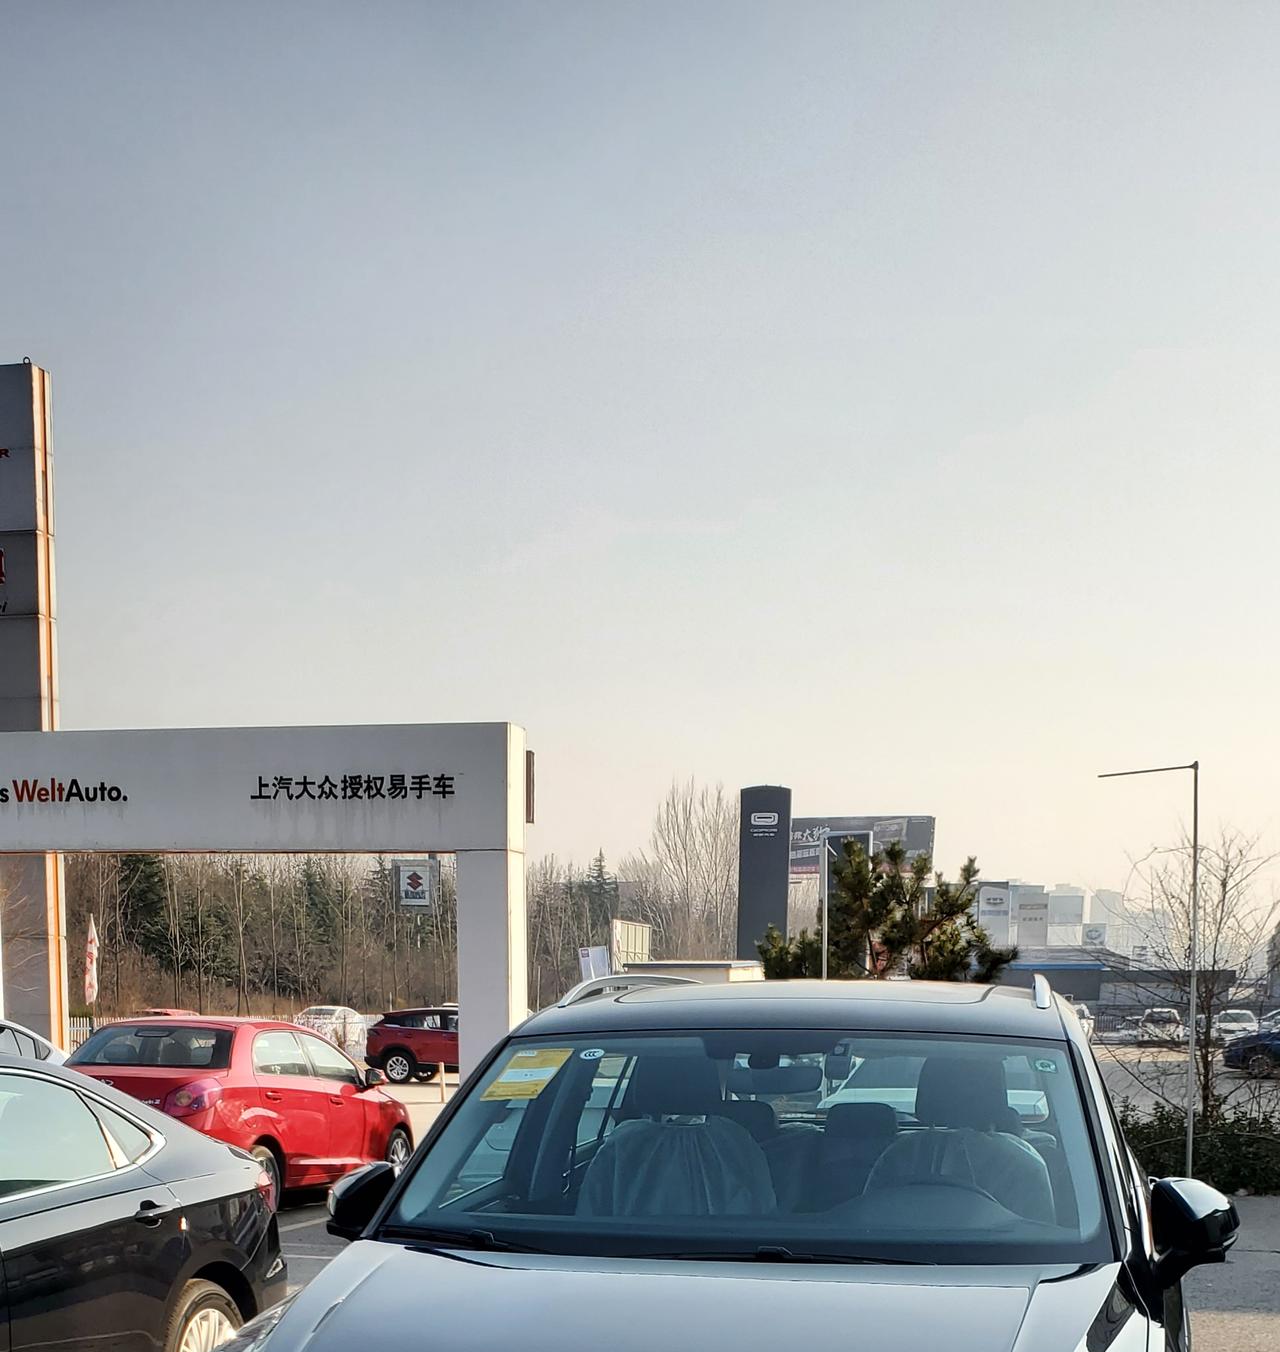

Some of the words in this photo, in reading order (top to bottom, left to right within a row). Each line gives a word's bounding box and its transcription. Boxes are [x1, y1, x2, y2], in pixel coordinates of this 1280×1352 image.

[12, 778, 128, 802] WeltAuto.
[250, 774, 455, 800] 上汽大众授权易手车
